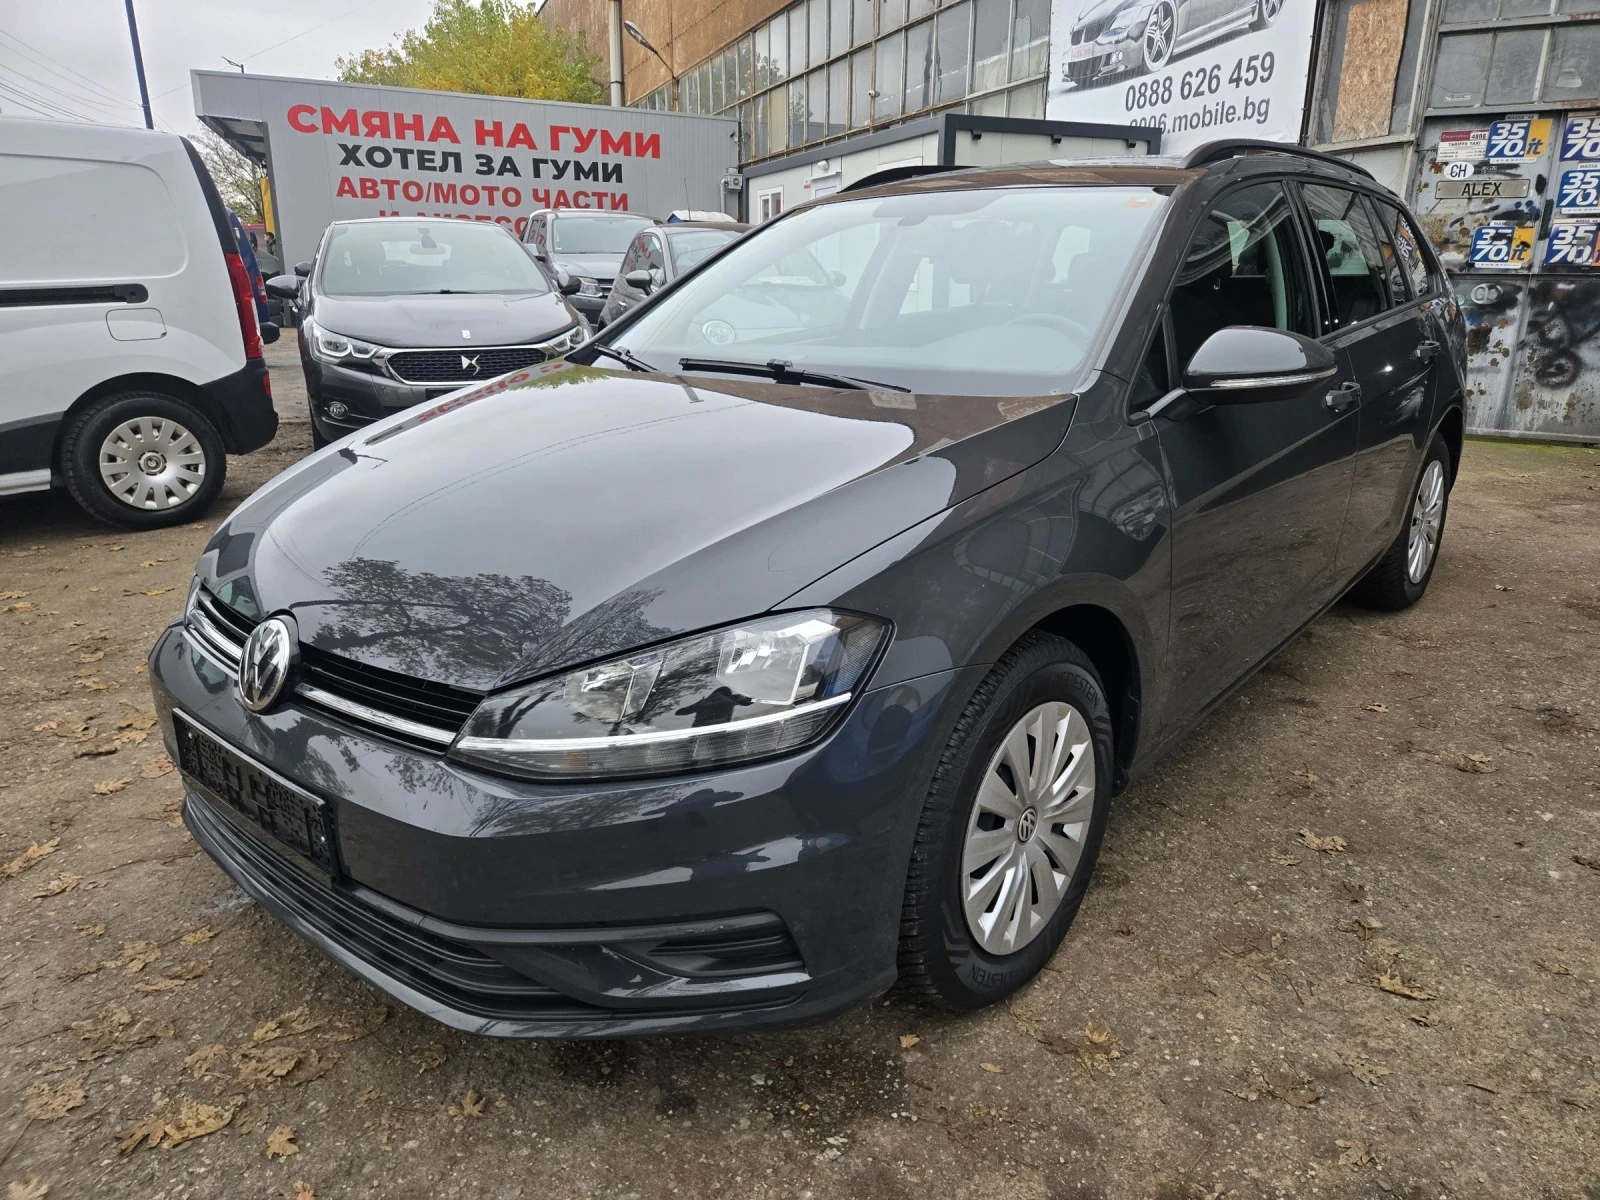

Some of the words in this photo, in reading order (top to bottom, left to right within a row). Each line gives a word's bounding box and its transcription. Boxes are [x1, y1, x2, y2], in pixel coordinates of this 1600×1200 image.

[1125, 76, 1173, 112] 0888
[1180, 64, 1222, 100] 626
[1228, 51, 1275, 89] 459
[287, 104, 461, 144] СМЯНА
[474, 119, 538, 150] НА
[550, 125, 661, 159] ГУМИ
[1491, 122, 1528, 140] 35
[338, 143, 462, 173] ХОТЕЛ
[475, 154, 522, 177] ЗА
[532, 158, 623, 183] ГУМИ
[1450, 164, 1467, 178] CH
[1461, 182, 1502, 196] ALEX
[1563, 172, 1599, 190] 35
[336, 176, 522, 207] АВТО/МОТО
[532, 188, 629, 212] ЧАСТИ
[1553, 225, 1597, 245] 35
